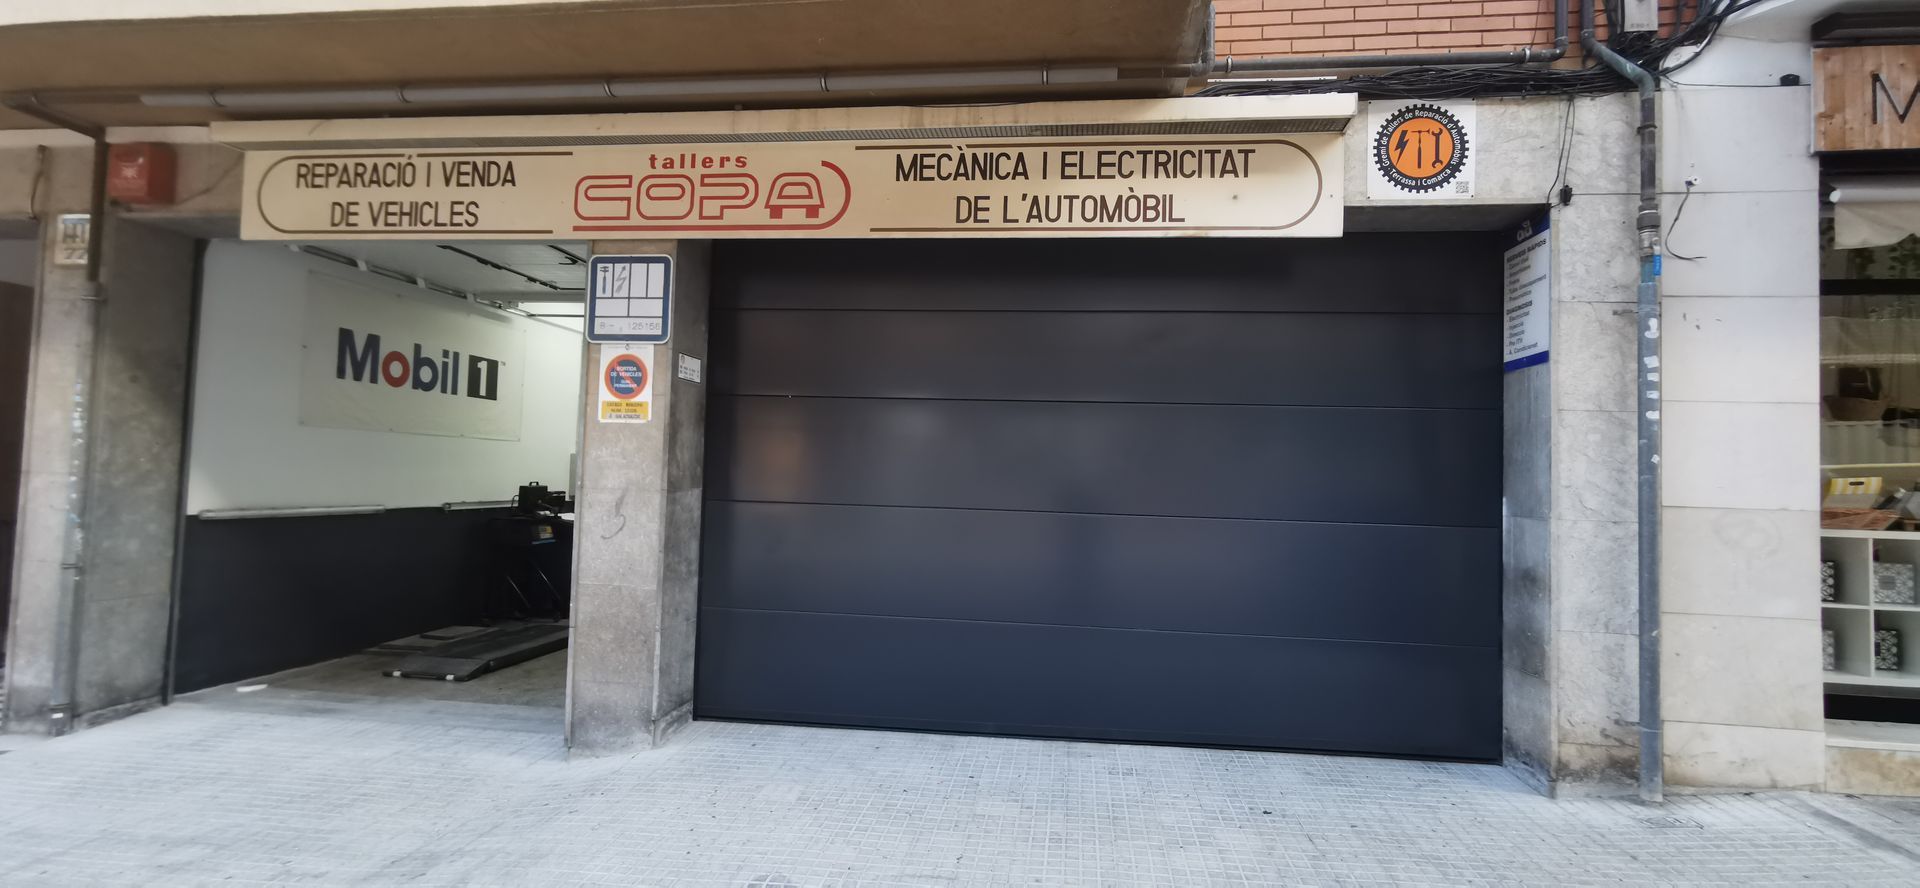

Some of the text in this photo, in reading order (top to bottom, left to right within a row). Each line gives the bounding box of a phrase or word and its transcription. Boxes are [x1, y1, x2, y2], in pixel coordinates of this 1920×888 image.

[1404, 111, 1413, 120] de
[1415, 109, 1449, 125] Reparació
[1384, 117, 1404, 136] Tallers
[1381, 136, 1389, 145] de
[649, 153, 748, 169] tallers
[895, 145, 1030, 182] MECÀNICA
[1060, 149, 1256, 180] ELECTRICITAT
[1380, 146, 1390, 167] Gremi
[296, 154, 417, 188] REPARACIÓ
[442, 160, 516, 188] VENDA
[1389, 168, 1416, 186] Terrassa
[1422, 168, 1452, 186] Comarca
[330, 200, 480, 228] DE VEHICLES
[955, 187, 1186, 223] DE L'AUTOMÒBIL
[336, 327, 459, 395] Mobil
